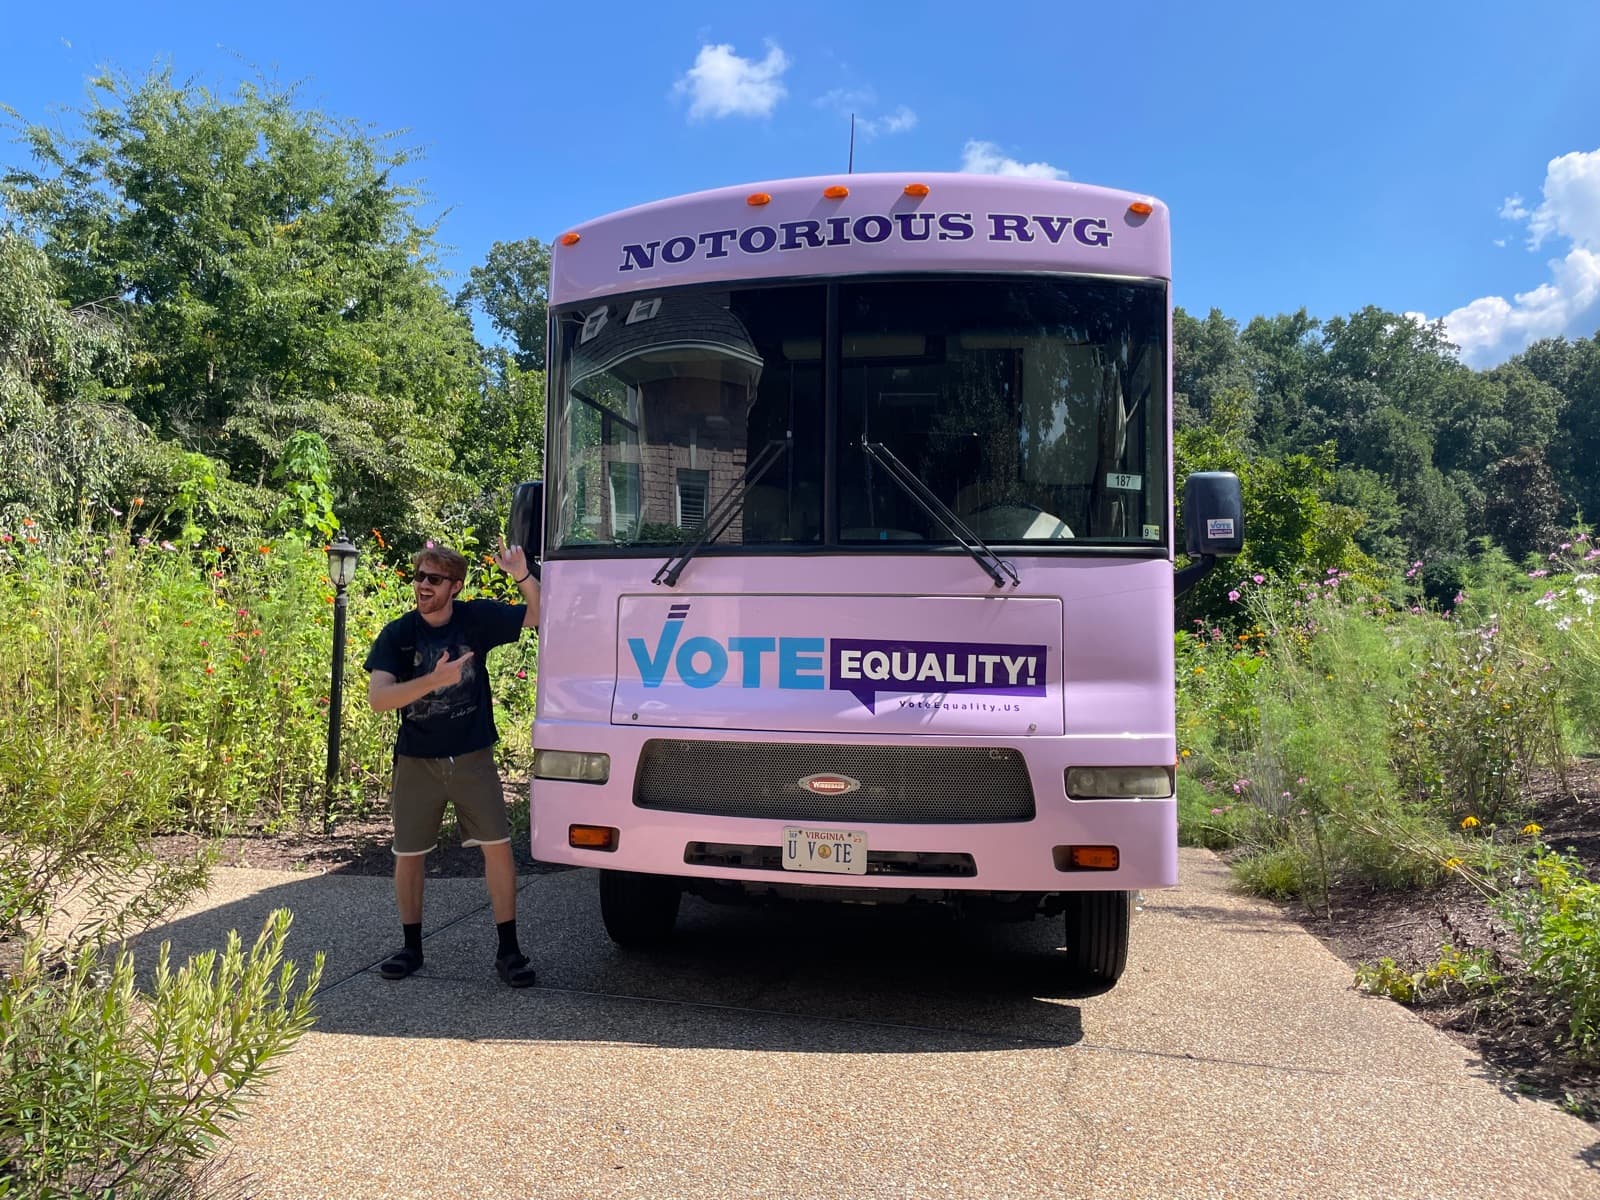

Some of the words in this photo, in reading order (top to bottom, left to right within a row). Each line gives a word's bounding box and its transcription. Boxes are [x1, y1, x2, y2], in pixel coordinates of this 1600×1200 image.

[617, 211, 977, 272] NOTORIOUS
[987, 212, 1114, 248] RVG
[1115, 475, 1131, 487] 187
[627, 605, 825, 690] VOTE
[840, 650, 1037, 686] EQUALITY!
[899, 700, 1021, 712] VoteEquality.US
[805, 831, 845, 841] VIRGINIA
[788, 840, 797, 860] U
